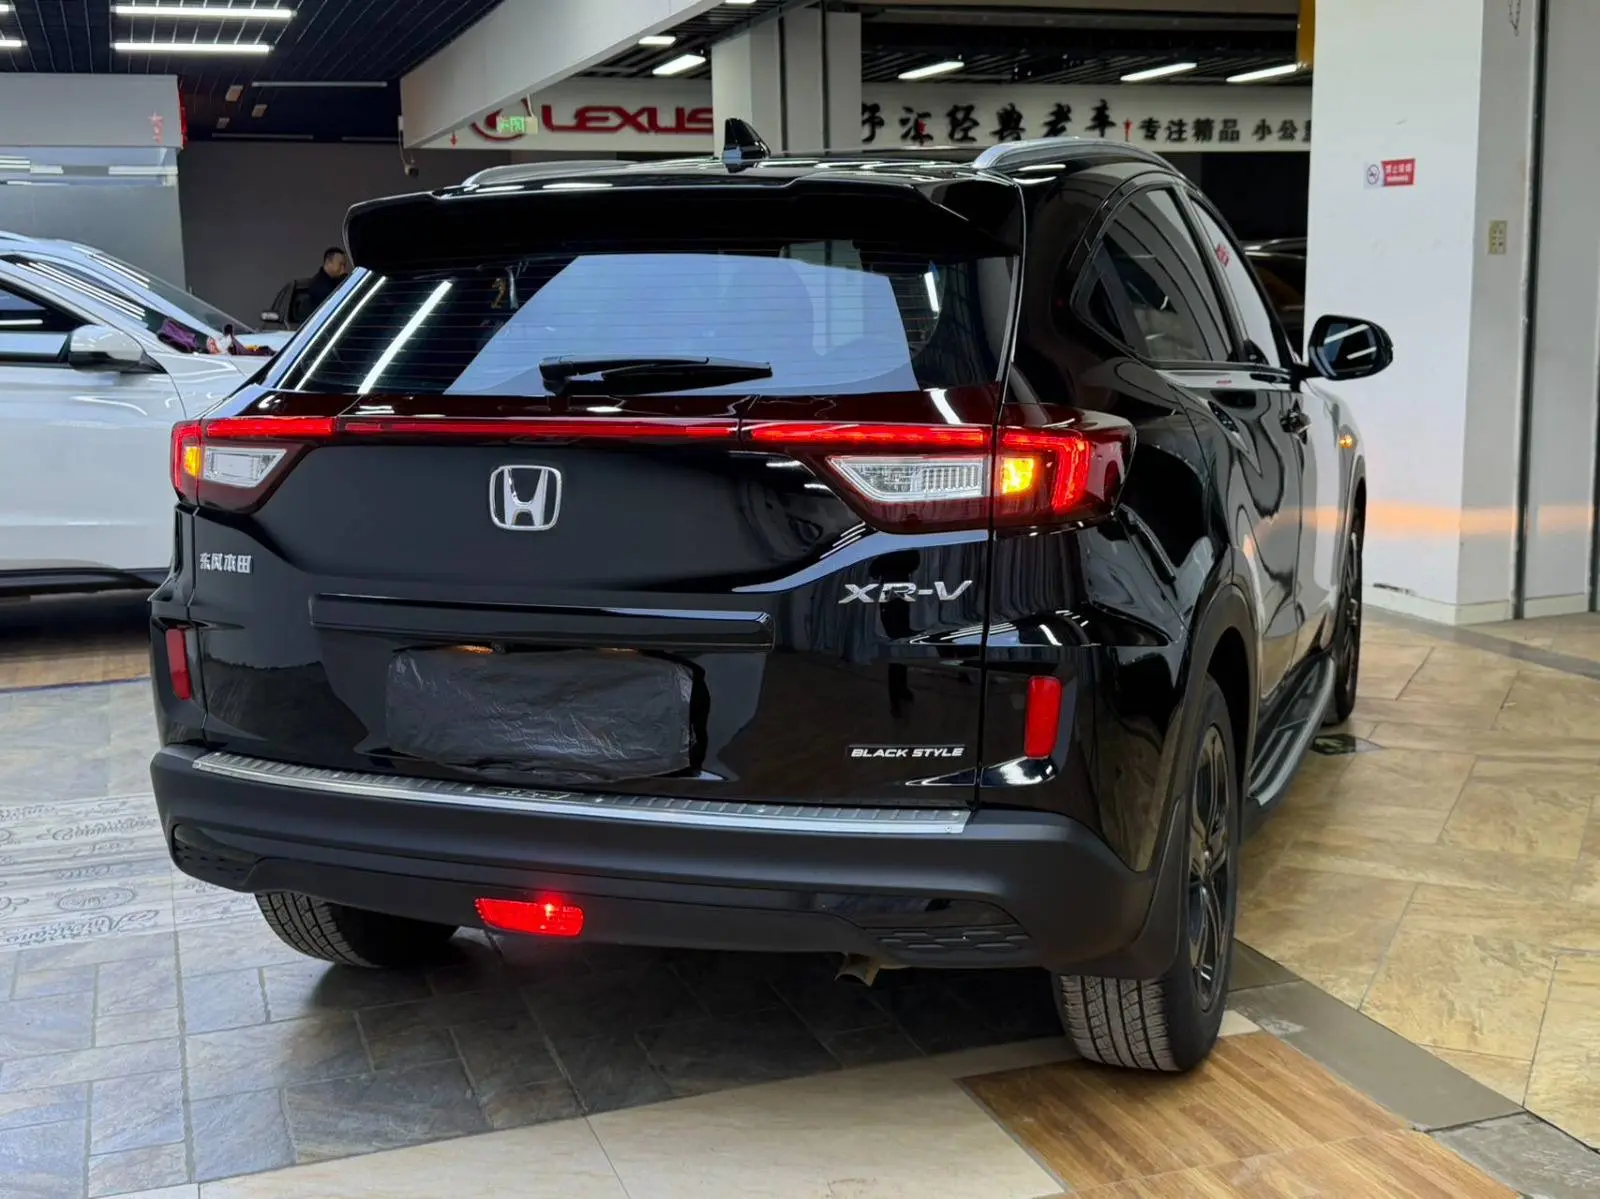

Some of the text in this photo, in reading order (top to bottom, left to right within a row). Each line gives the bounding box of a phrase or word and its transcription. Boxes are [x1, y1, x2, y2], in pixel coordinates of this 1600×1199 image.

[541, 104, 714, 134] LEXUS
[1139, 116, 1240, 143] 专注精品
[200, 552, 252, 573] 东风本田
[838, 580, 973, 604] XR-V
[850, 747, 965, 758] BLACK STYLE
